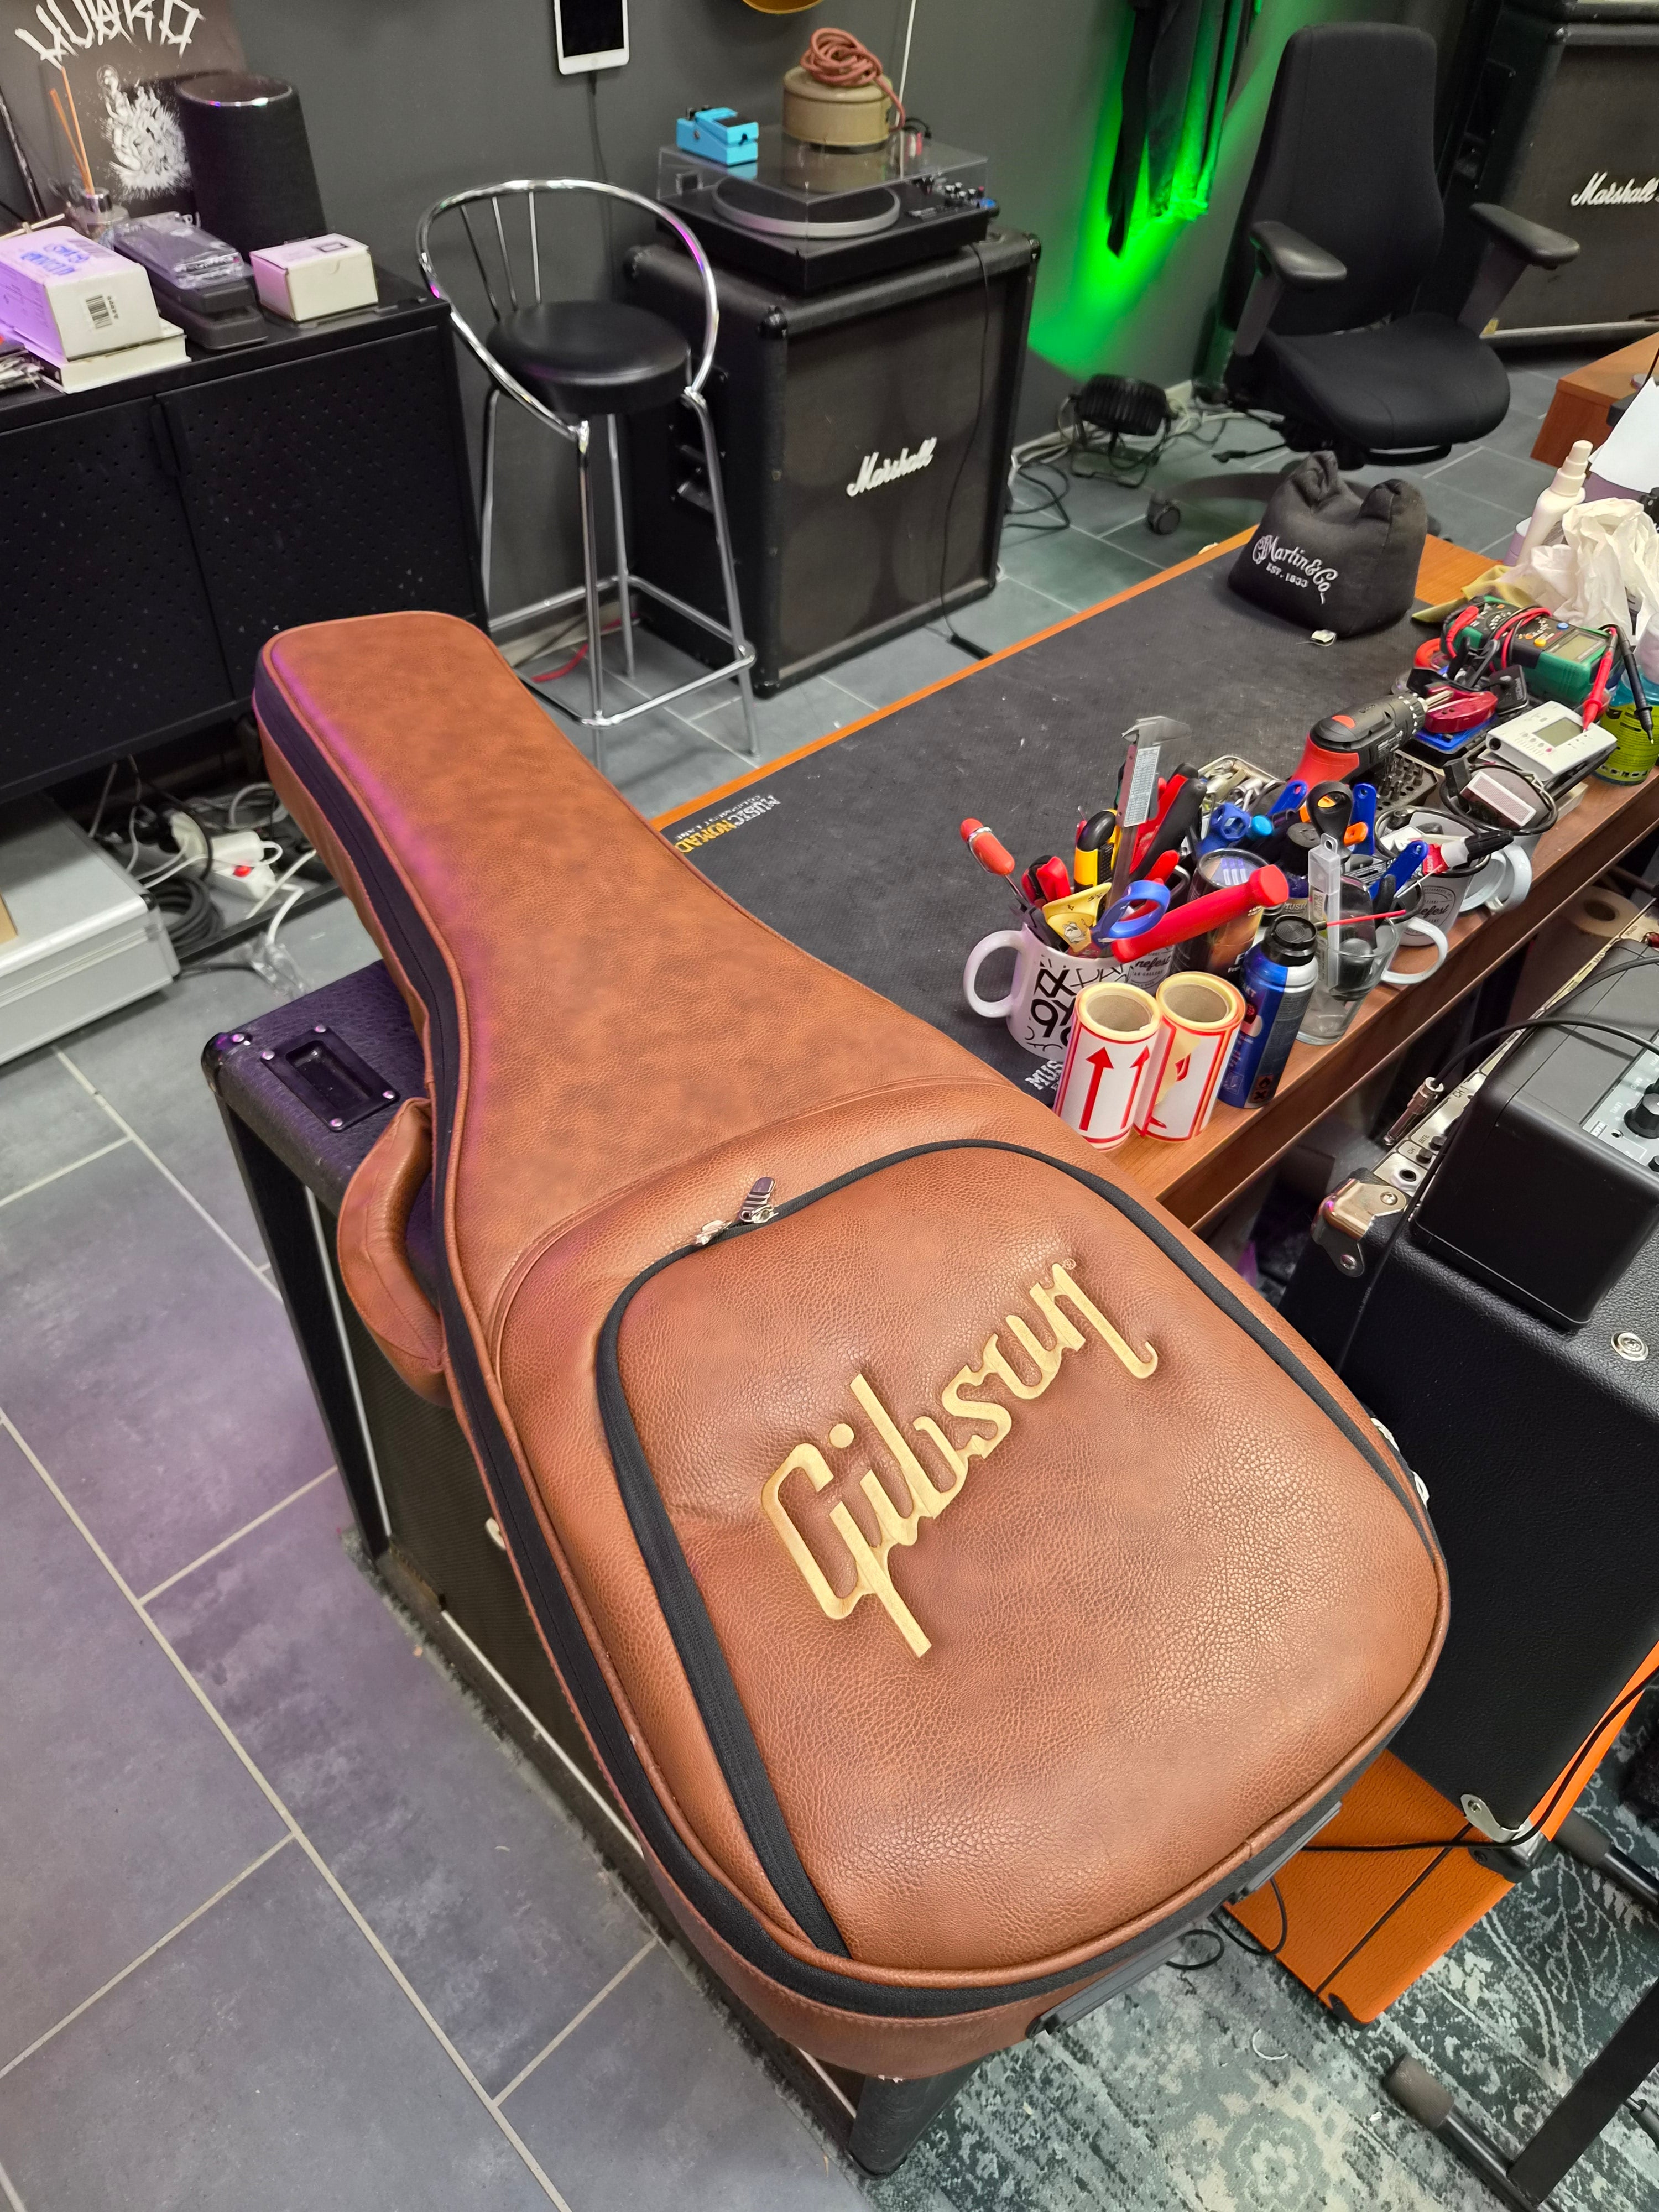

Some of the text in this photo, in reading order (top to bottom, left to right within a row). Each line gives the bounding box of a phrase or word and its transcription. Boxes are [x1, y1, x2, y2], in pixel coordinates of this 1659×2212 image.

[1571, 171, 1659, 207] Marshall
[846, 436, 937, 497] Marshall
[1418, 1134, 1430, 1144] BITE
[761, 1263, 1158, 1657] Gibson
